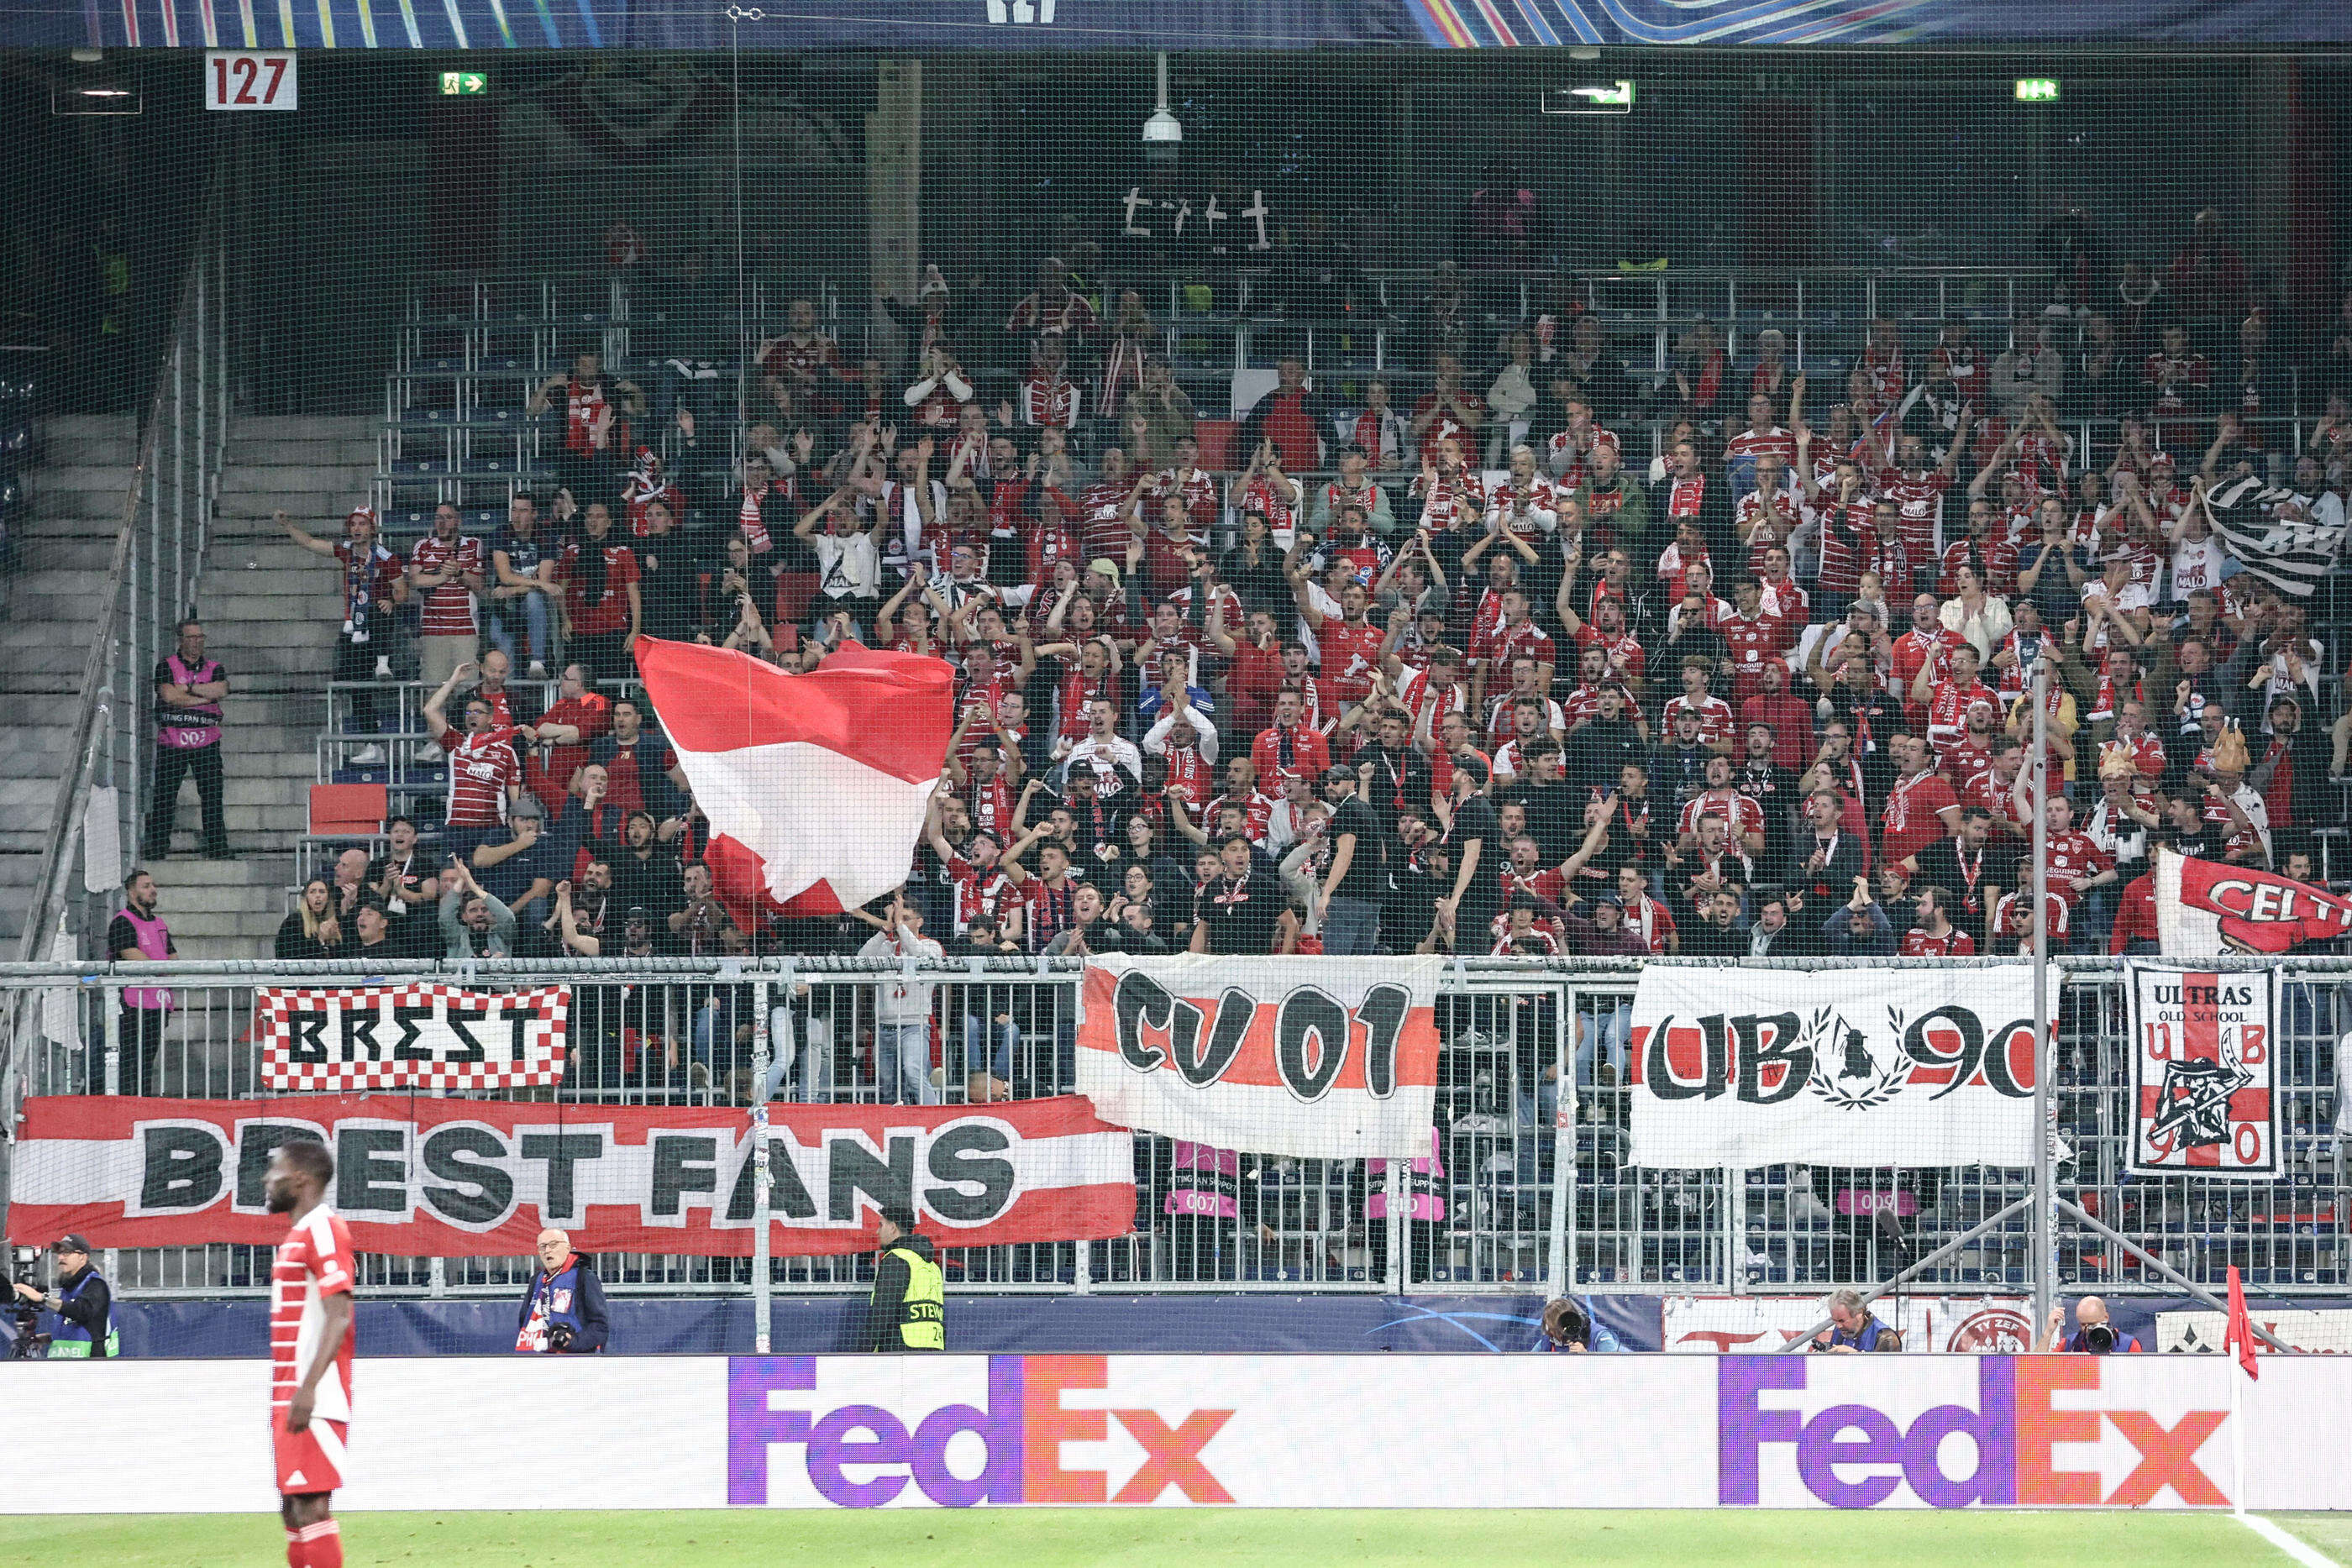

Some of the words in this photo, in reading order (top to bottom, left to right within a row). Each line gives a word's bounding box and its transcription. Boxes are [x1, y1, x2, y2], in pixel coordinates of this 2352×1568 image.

[213, 57, 288, 105] 127
[1095, 511, 1116, 519] ALO
[1511, 522, 1535, 531] MALO
[1903, 507, 1925, 517] MALO
[2178, 575, 2206, 587] MALO
[467, 768, 492, 781] MALO
[2154, 985, 2252, 1005] ULTRAS
[2159, 1010, 2185, 1022] OLD
[2194, 1010, 2248, 1023] SCHOOL
[288, 1006, 539, 1063] BREST
[1274, 982, 1411, 1104] 01
[2145, 1023, 2172, 1061] U
[2240, 1024, 2266, 1064] B
[1648, 1011, 1814, 1104] UB
[1904, 1004, 2052, 1101] 90
[2235, 1122, 2260, 1165] 0
[652, 1124, 1015, 1222] FANS
[1186, 1193, 1216, 1212] 007
[1973, 1320, 1993, 1334] TY
[1995, 1319, 2019, 1333] ZEF
[727, 1355, 1236, 1508] FedEx
[1718, 1355, 2231, 1509] FedEx
